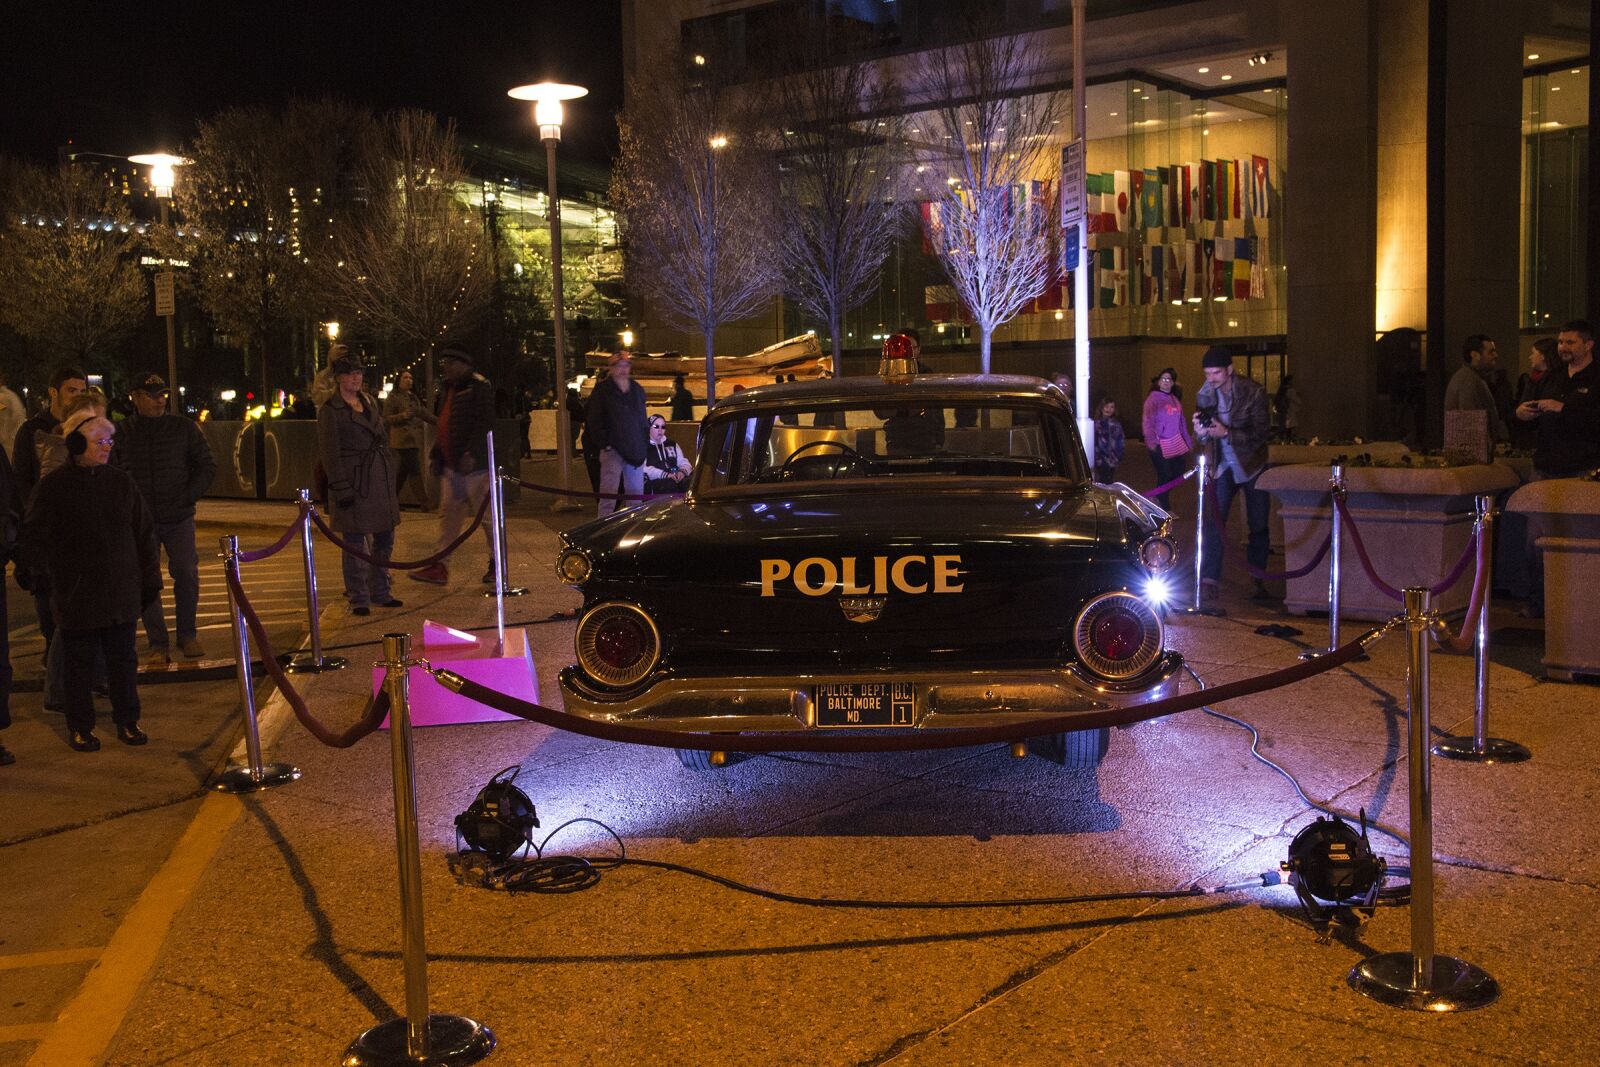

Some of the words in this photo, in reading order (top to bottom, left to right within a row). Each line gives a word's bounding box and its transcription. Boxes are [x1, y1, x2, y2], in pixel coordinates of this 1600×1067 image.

[760, 555, 964, 596] POLICE
[821, 684, 854, 697] POLICE
[861, 684, 889, 697] DEPT.
[828, 697, 881, 710] BALTIMORE
[847, 710, 863, 723] MD.
[899, 706, 907, 723] 1
